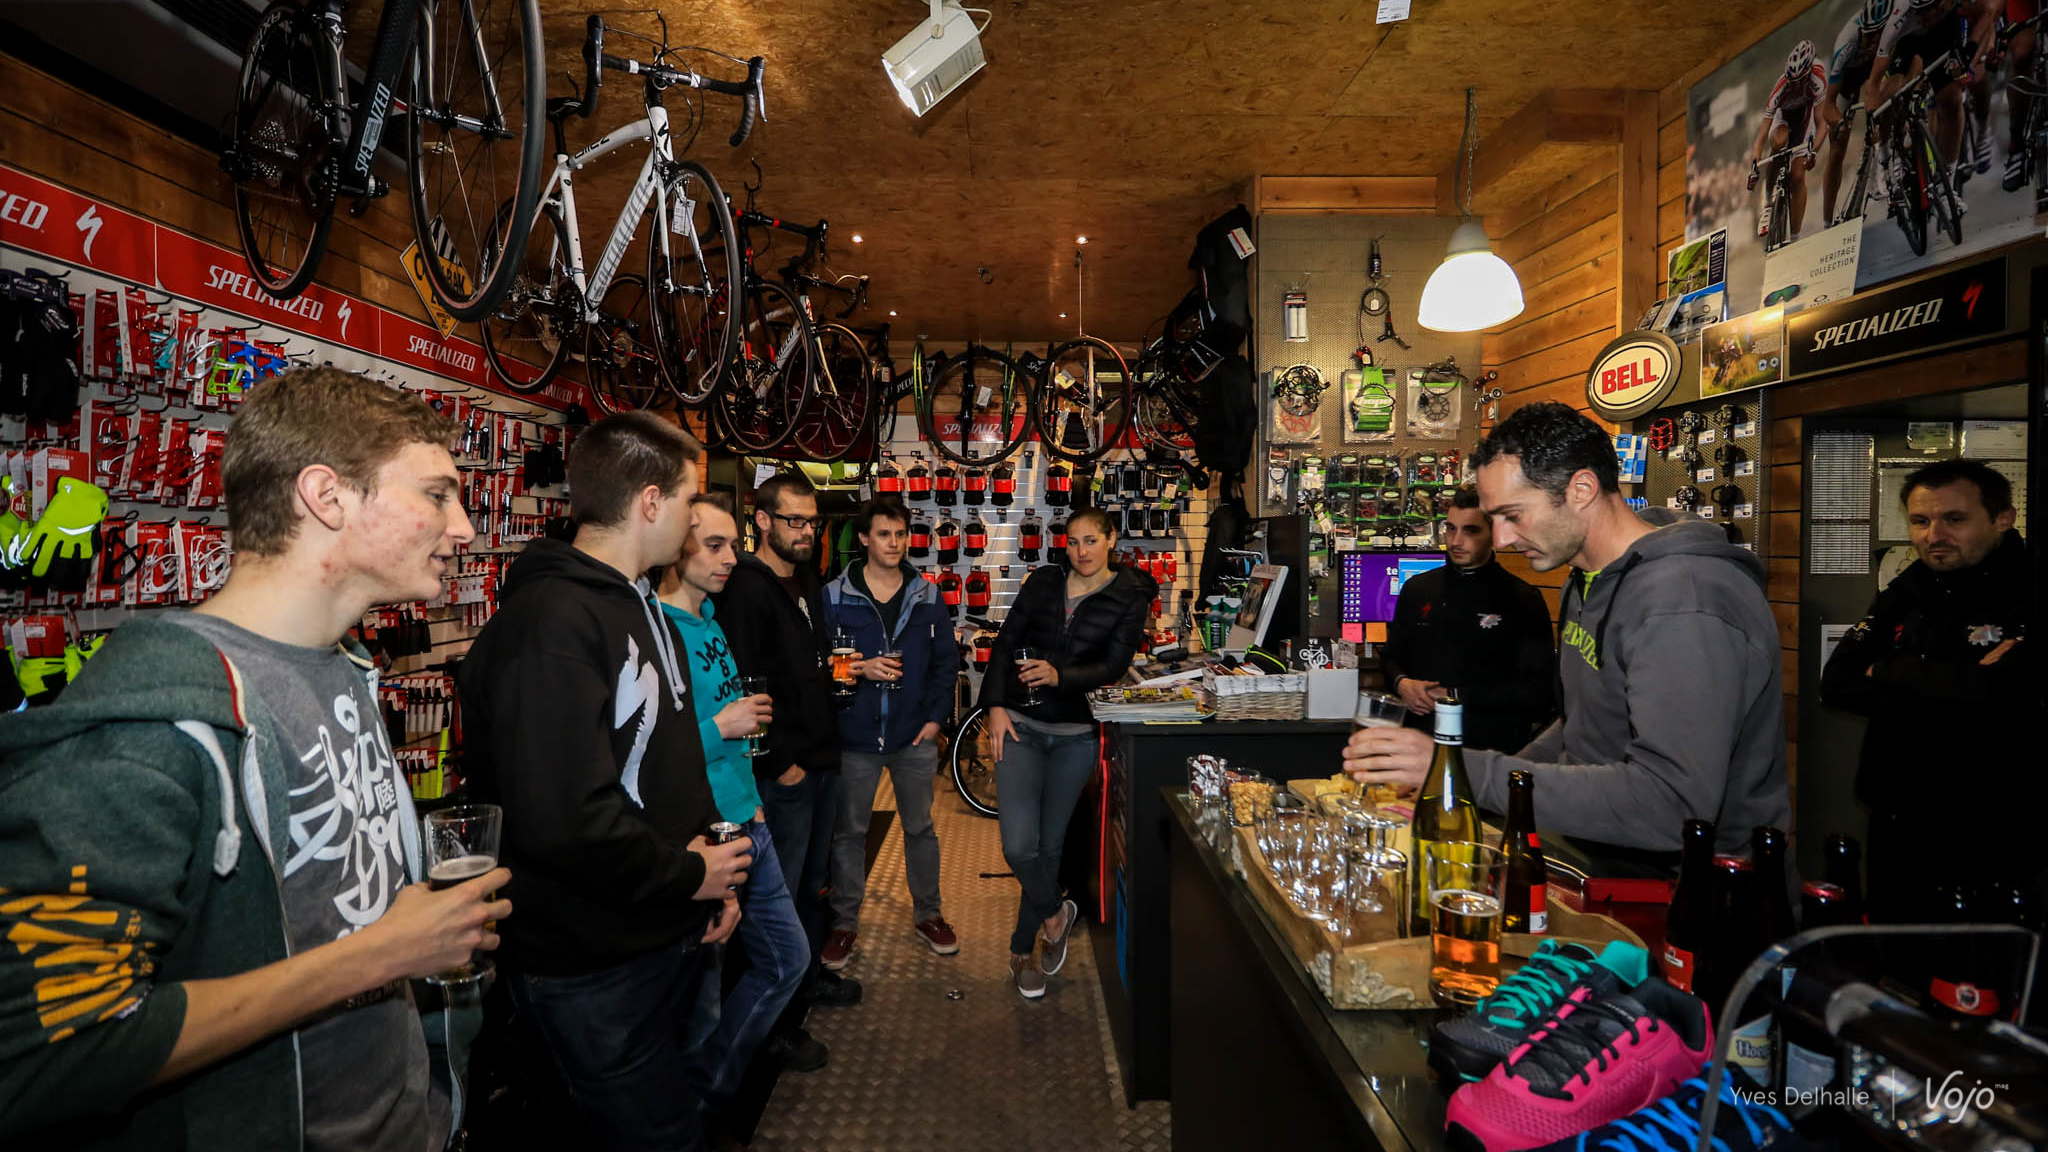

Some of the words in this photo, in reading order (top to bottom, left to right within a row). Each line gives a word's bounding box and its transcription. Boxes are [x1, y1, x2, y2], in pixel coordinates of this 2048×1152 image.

[355, 82, 391, 177] SPEIZED
[0, 190, 49, 230] ED
[1820, 245, 1857, 263] HERITAGE
[1843, 234, 1857, 246] THE
[1810, 256, 1855, 278] COLLECTION
[1809, 298, 1944, 353] SPECIALIZED
[407, 334, 477, 372] SPECIALIZED
[1602, 357, 1657, 395] BELL
